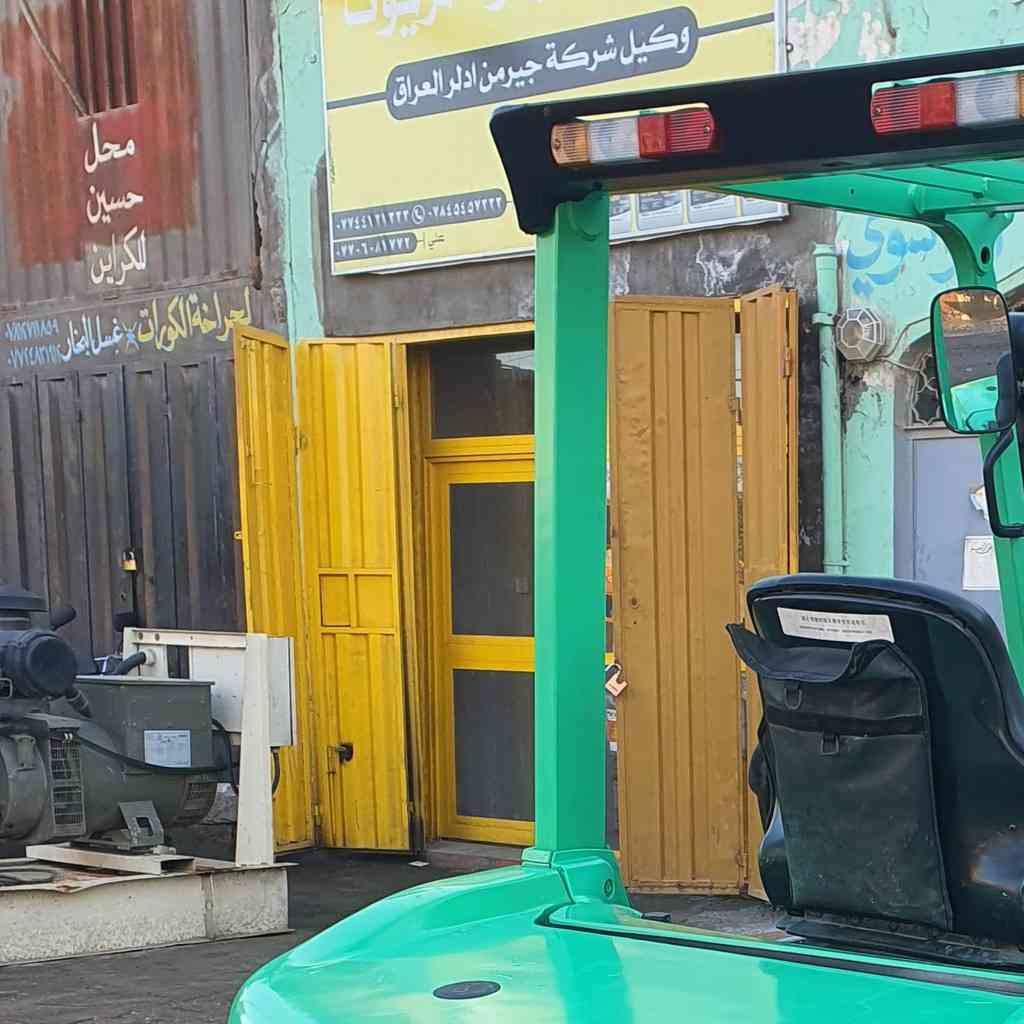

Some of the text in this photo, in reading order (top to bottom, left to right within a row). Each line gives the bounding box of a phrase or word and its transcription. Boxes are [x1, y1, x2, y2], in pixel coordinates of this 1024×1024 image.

[545, 34, 618, 73] شركة
[619, 22, 691, 66] وكيل
[391, 66, 444, 106] العراق
[479, 56, 543, 93] جيرمن
[84, 122, 136, 173] محل
[86, 184, 144, 224] حسين
